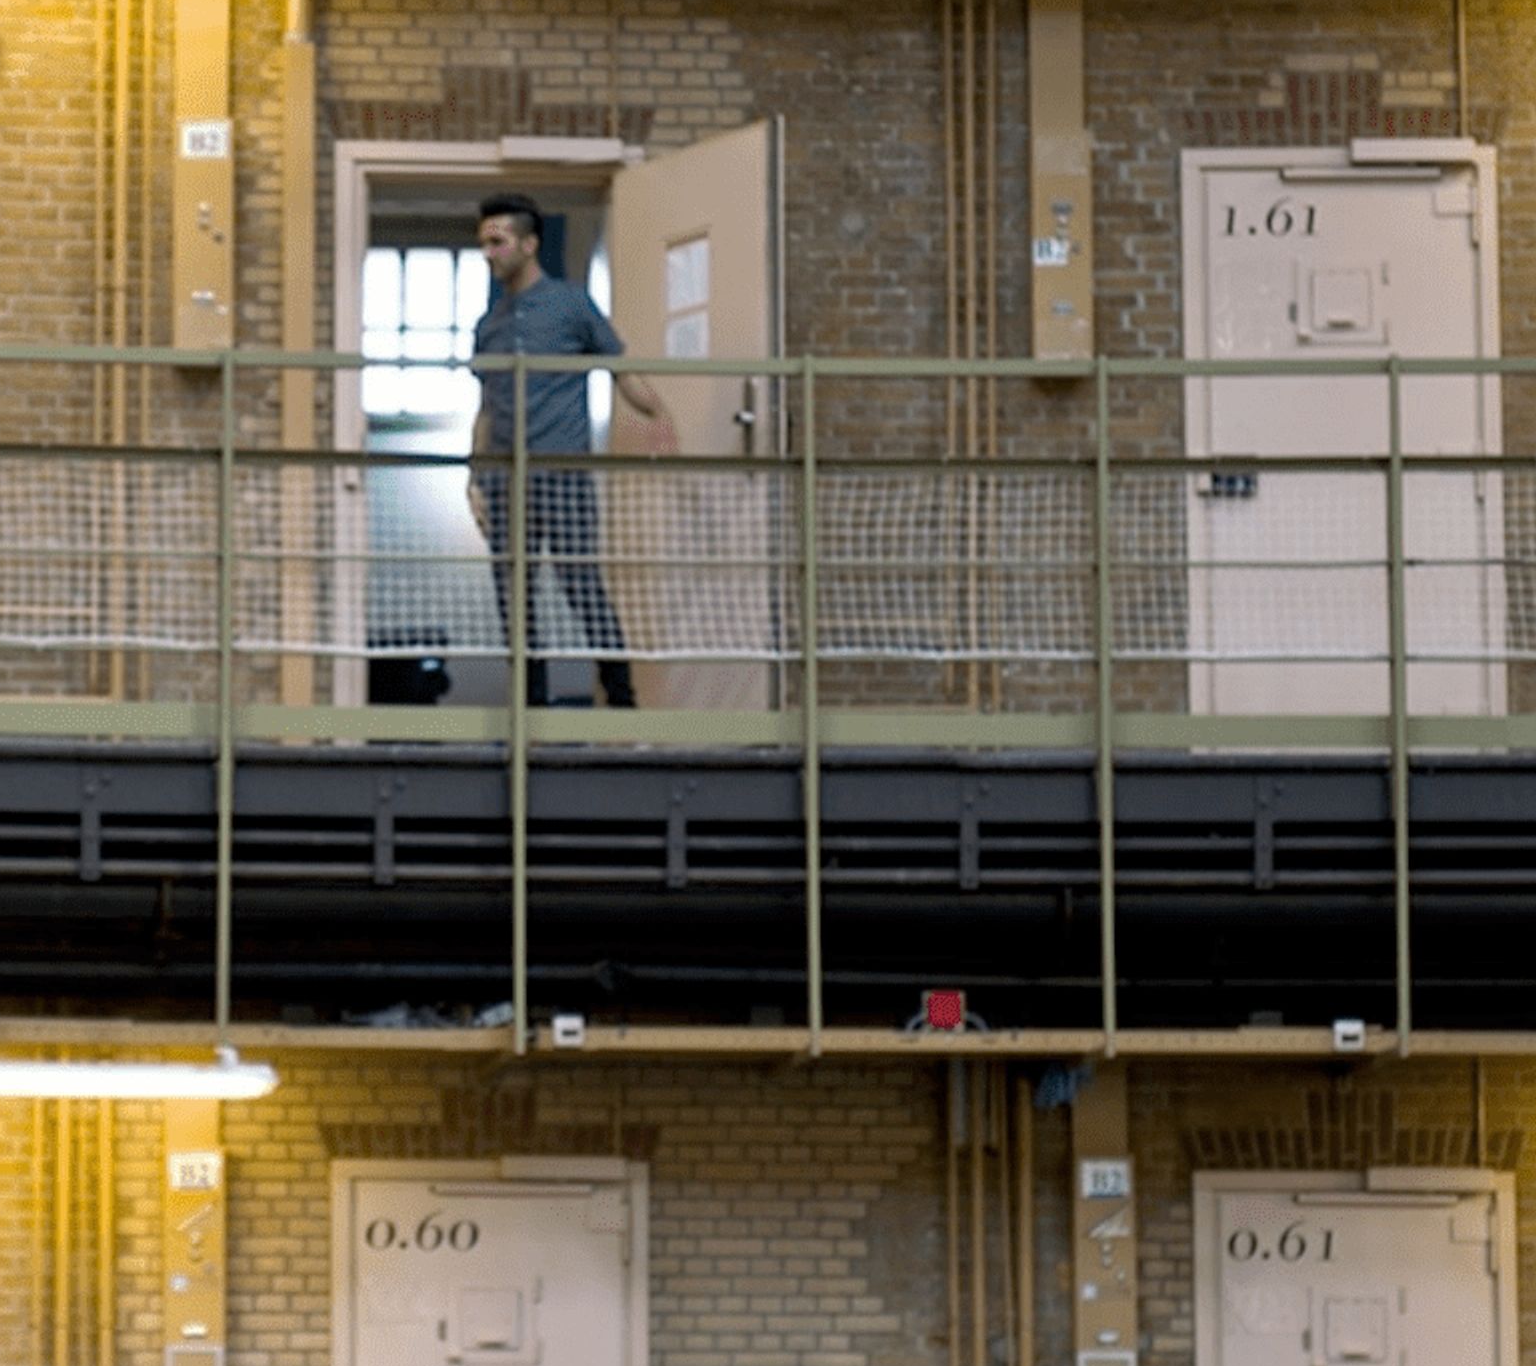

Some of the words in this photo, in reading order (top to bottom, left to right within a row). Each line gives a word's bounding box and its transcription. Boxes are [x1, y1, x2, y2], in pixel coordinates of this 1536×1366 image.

[1224, 196, 1317, 237] 1.61
[364, 1210, 481, 1252] 0.60
[1226, 1220, 1335, 1262] 0.61
